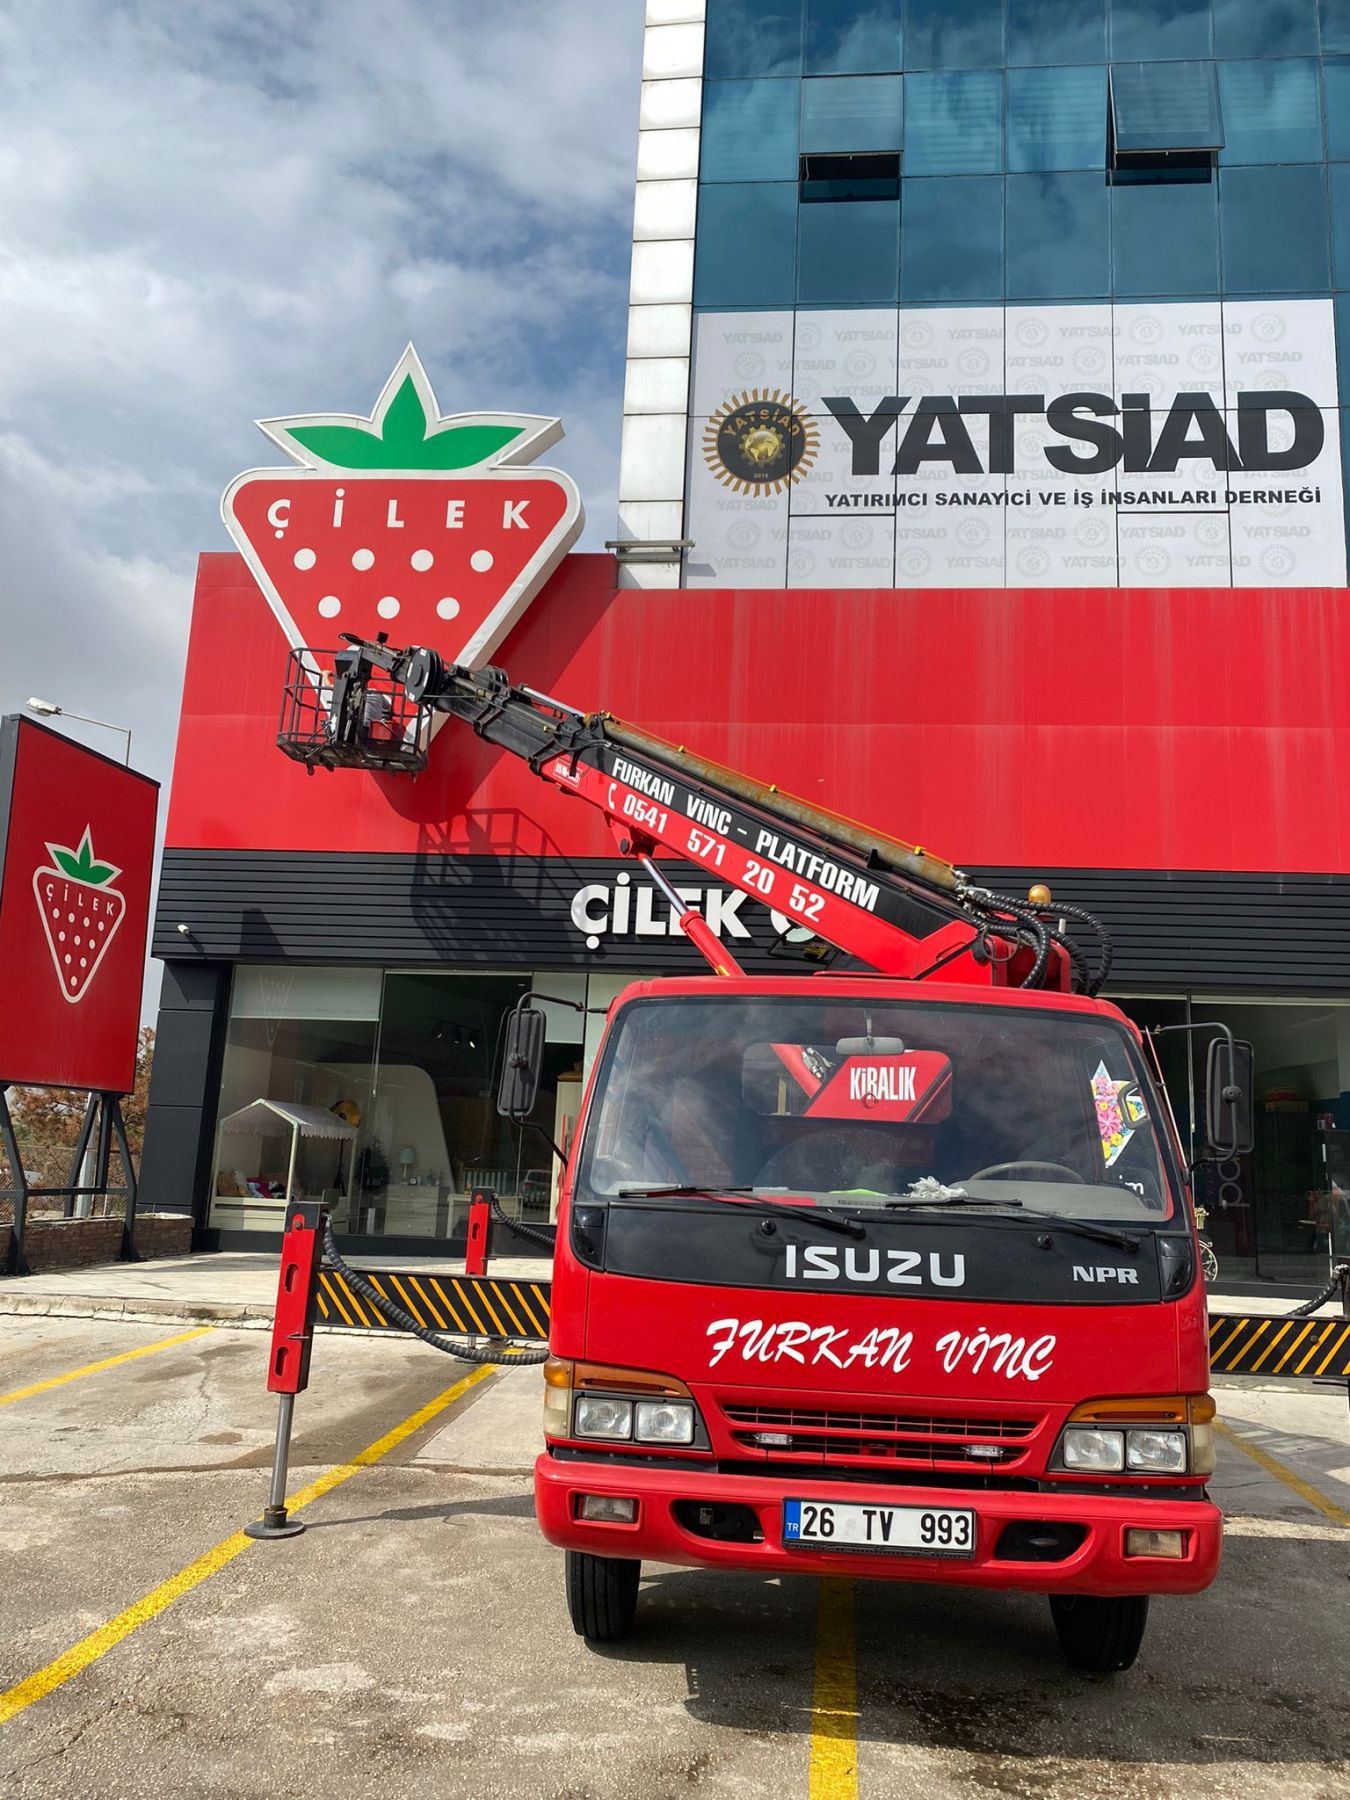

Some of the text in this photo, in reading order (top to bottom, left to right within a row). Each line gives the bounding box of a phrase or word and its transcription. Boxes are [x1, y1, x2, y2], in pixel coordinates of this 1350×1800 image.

[267, 488, 531, 539] ÇİLEK
[824, 486, 1321, 509] YATIRIMCI SANAYİCİ VE İŞ İNSANLARI DERNEĞİ
[611, 757, 675, 806] FURKAN
[755, 829, 880, 912] PLATFORM
[623, 793, 825, 923] 0541 571 20 52
[785, 1244, 966, 1288] ISUZU
[1072, 1265, 1140, 1284] NPR
[706, 1317, 914, 1374] FURKAN
[787, 1506, 970, 1545] TR 26 TV 993
